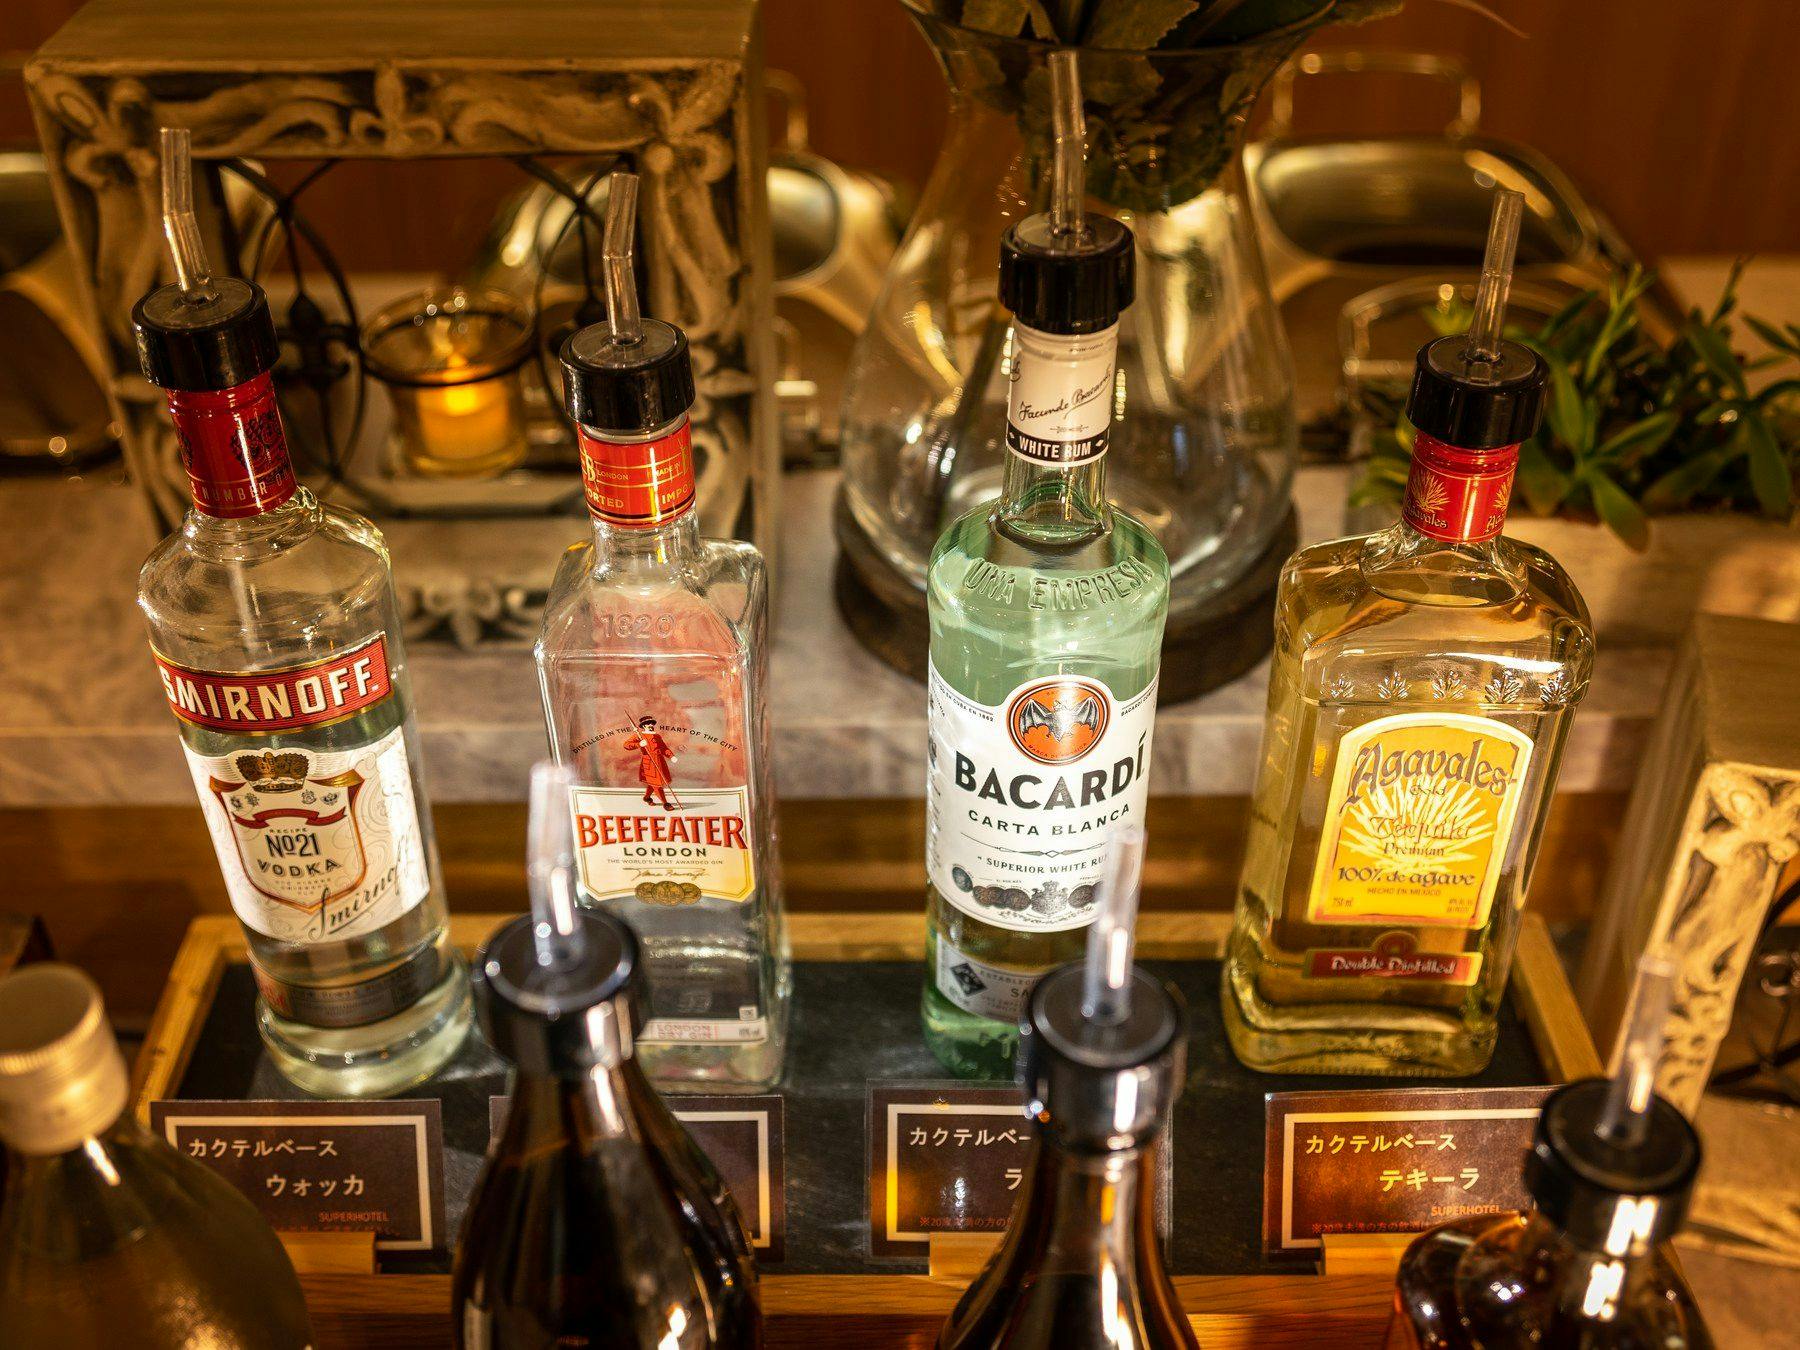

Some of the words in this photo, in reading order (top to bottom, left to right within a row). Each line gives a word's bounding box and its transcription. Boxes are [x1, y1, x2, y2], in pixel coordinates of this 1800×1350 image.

[1019, 435, 1060, 458] WHITE
[1064, 441, 1091, 457] RUM
[964, 557, 1016, 604] UNA
[1028, 555, 1153, 611] EMPRESA
[573, 733, 605, 754] DISTILLED
[616, 726, 631, 735] THE
[659, 725, 687, 734] HEART
[689, 729, 701, 738] OF
[703, 733, 718, 743] THE
[720, 740, 738, 752] CITY
[955, 730, 1147, 811] BACARDÍ
[1340, 738, 1508, 814] Agavales
[968, 809, 1040, 836] CARTA
[1051, 803, 1130, 836] BLANCA
[575, 814, 748, 849] BEEFEATER
[623, 847, 707, 857] LONDON
[257, 858, 341, 877] VODKA
[987, 857, 1044, 874] SUPERIOR
[1050, 861, 1087, 874] WHITE
[1338, 866, 1382, 882] 100%
[1409, 871, 1476, 887] agave
[1331, 955, 1383, 970] Double
[1388, 956, 1456, 975] Distilled
[189, 1138, 338, 1158] カクテルベース
[909, 1127, 1031, 1147] カクテルベー
[1305, 1134, 1457, 1155] カクテルベース
[266, 1174, 364, 1197] ウォッカ
[1004, 1167, 1023, 1190] ラ
[1379, 1167, 1480, 1192] テキーラ
[318, 1211, 391, 1222] SUPERHOTEL
[1431, 1204, 1500, 1217] SUPERHOTEL
